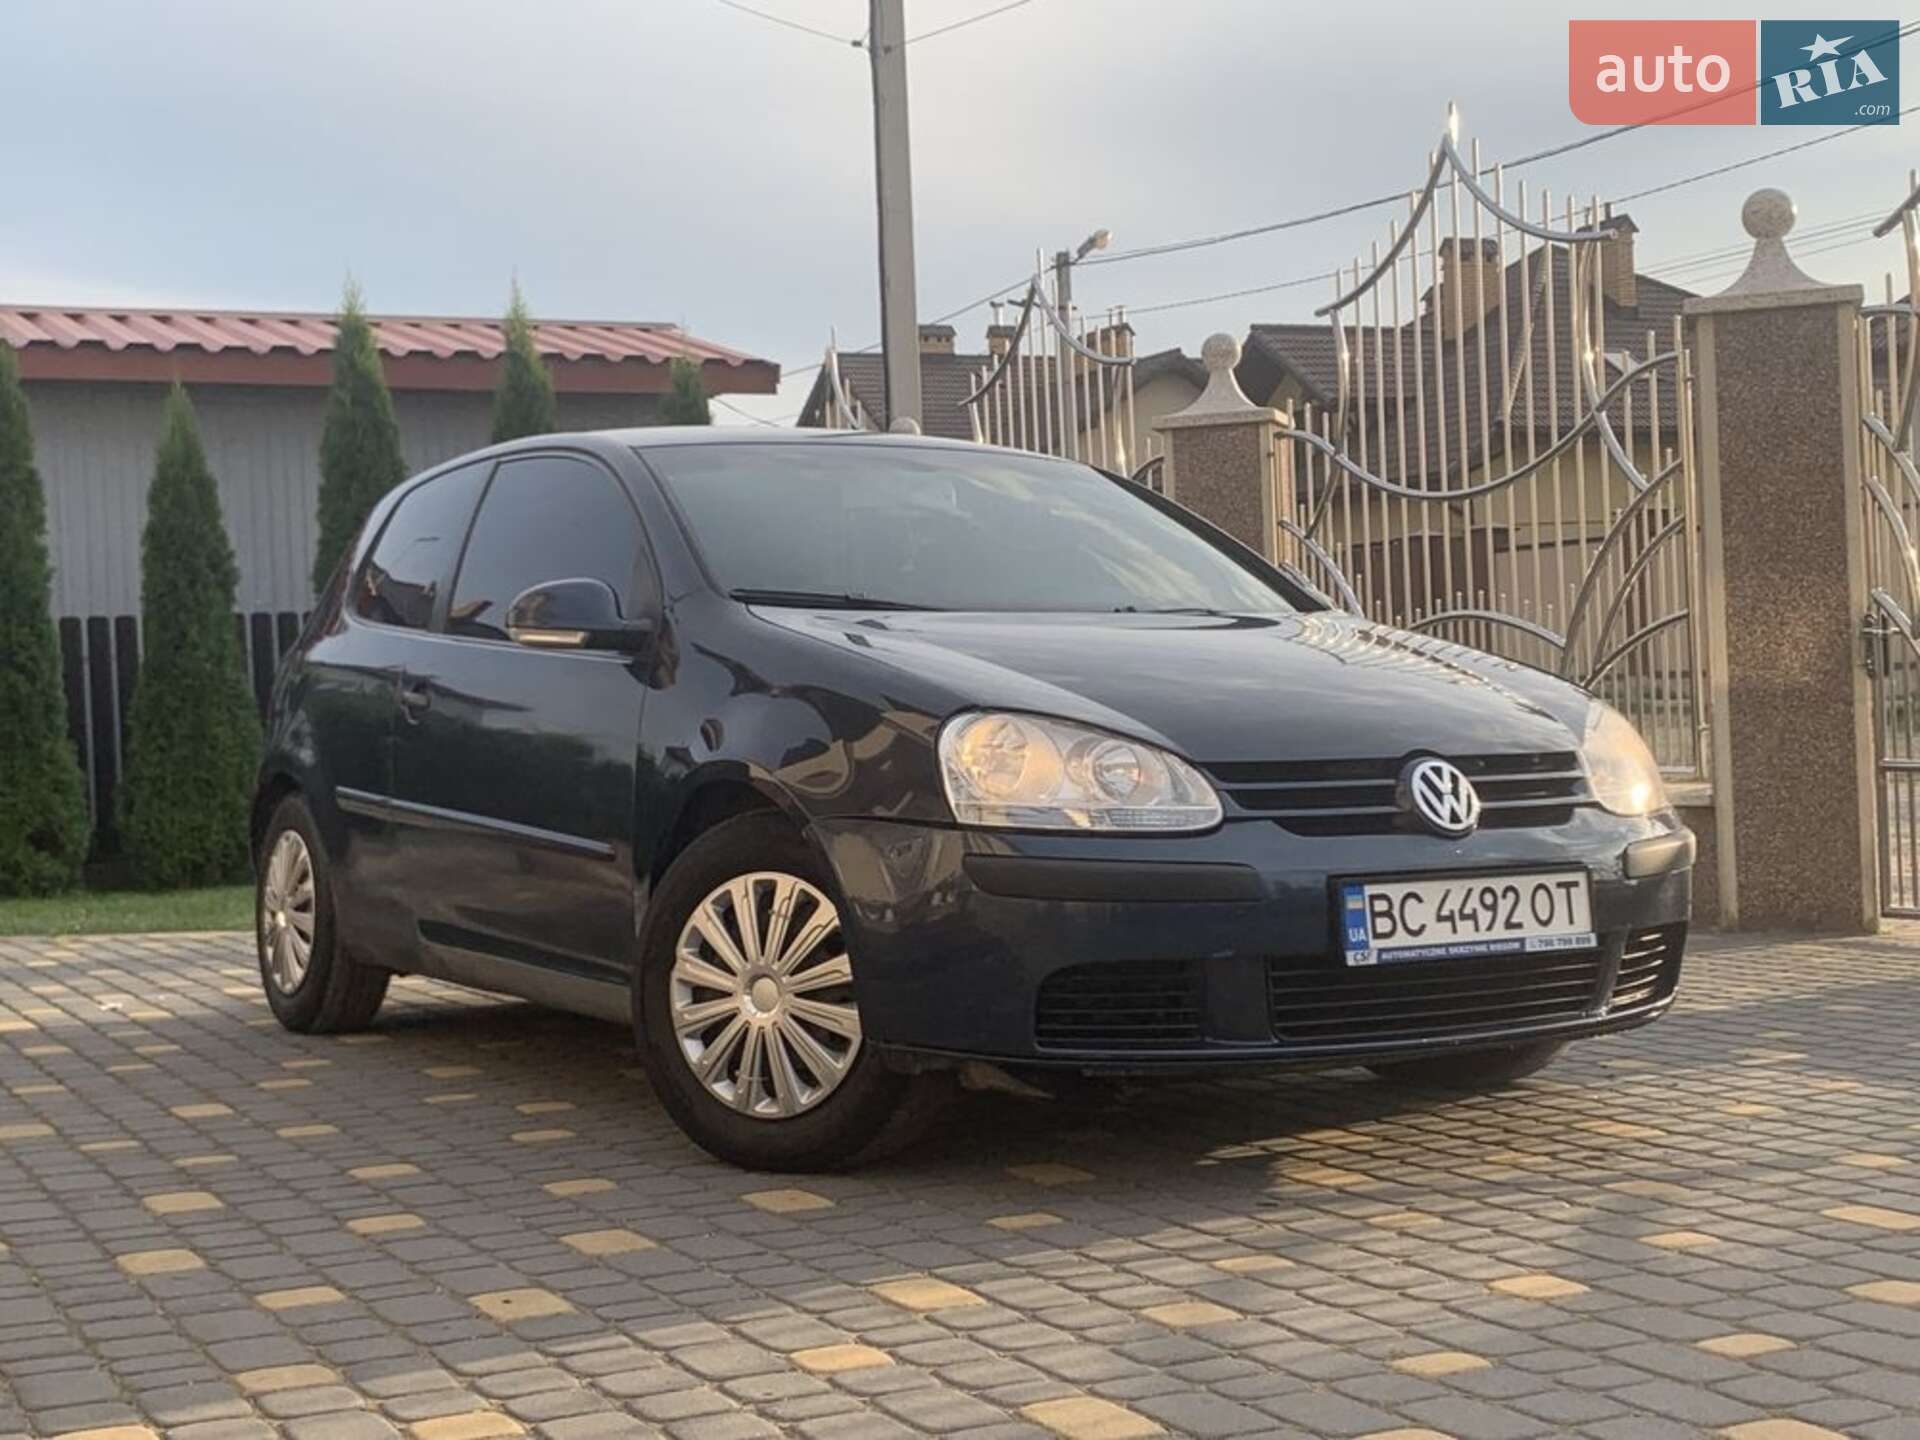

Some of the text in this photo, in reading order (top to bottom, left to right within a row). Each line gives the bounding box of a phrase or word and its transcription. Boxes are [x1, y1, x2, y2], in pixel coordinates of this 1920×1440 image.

[1367, 891, 1427, 941] BC
[1436, 885, 1524, 934] 4492
[1348, 928, 1367, 942] UA
